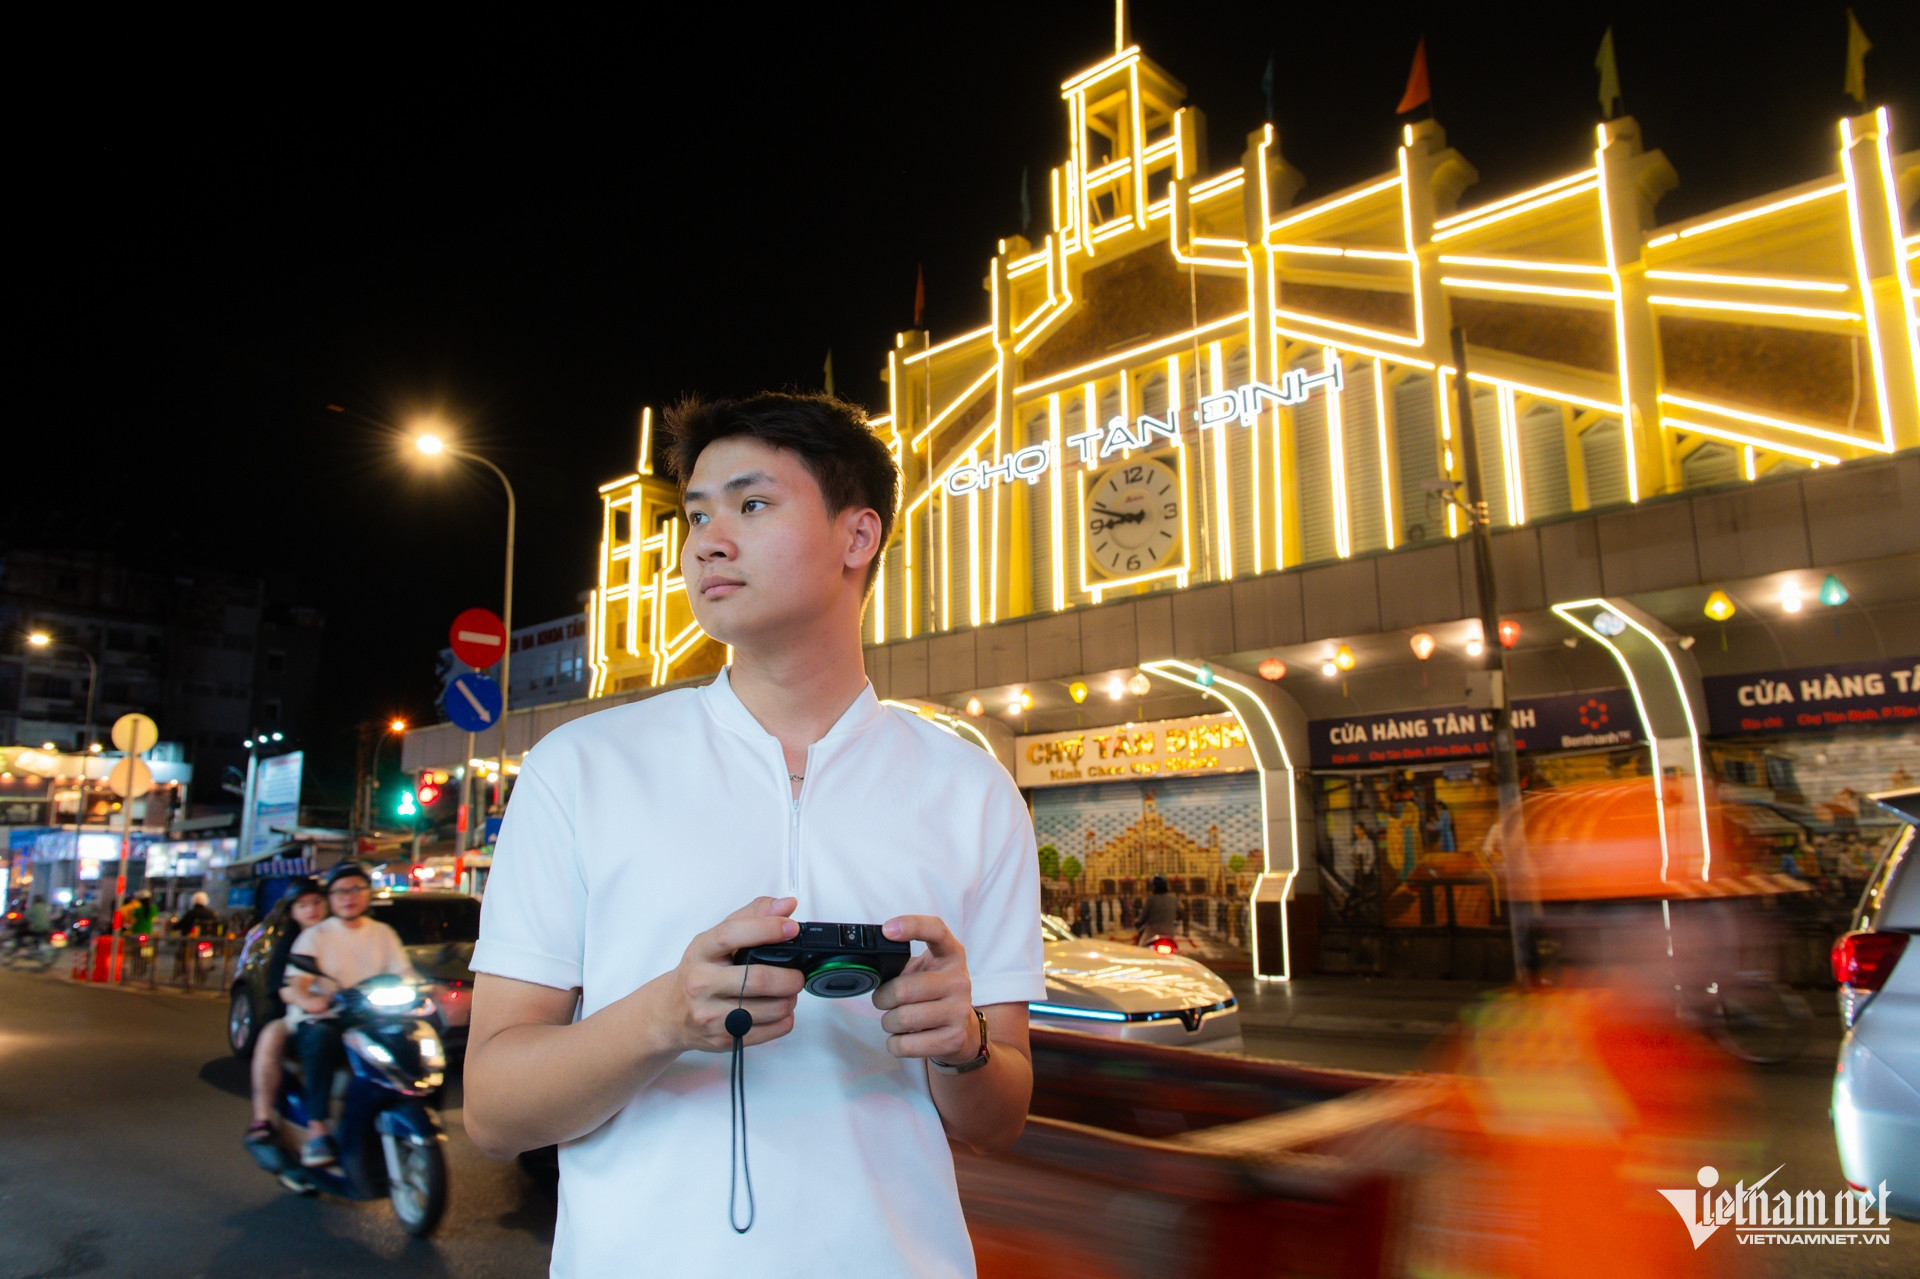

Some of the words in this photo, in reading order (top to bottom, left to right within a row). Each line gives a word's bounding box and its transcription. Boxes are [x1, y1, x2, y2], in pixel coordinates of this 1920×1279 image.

[947, 440, 1051, 496] CHỢ
[1066, 409, 1181, 463] TÂN
[1194, 357, 1344, 430] ĐỊNH
[1123, 466, 1144, 484] 12
[1164, 502, 1178, 520] 3
[1090, 519, 1104, 536] 9
[1126, 555, 1141, 572] 6
[1738, 679, 1795, 707] CỬA
[1800, 673, 1885, 701] HÀNG
[1329, 722, 1368, 745] CỬA
[1372, 718, 1429, 742] HÀNG
[1432, 712, 1476, 736] TÂN
[1026, 733, 1086, 766] CHỢ
[1093, 726, 1155, 760] TÂN
[1165, 722, 1246, 758] ĐỊNH
